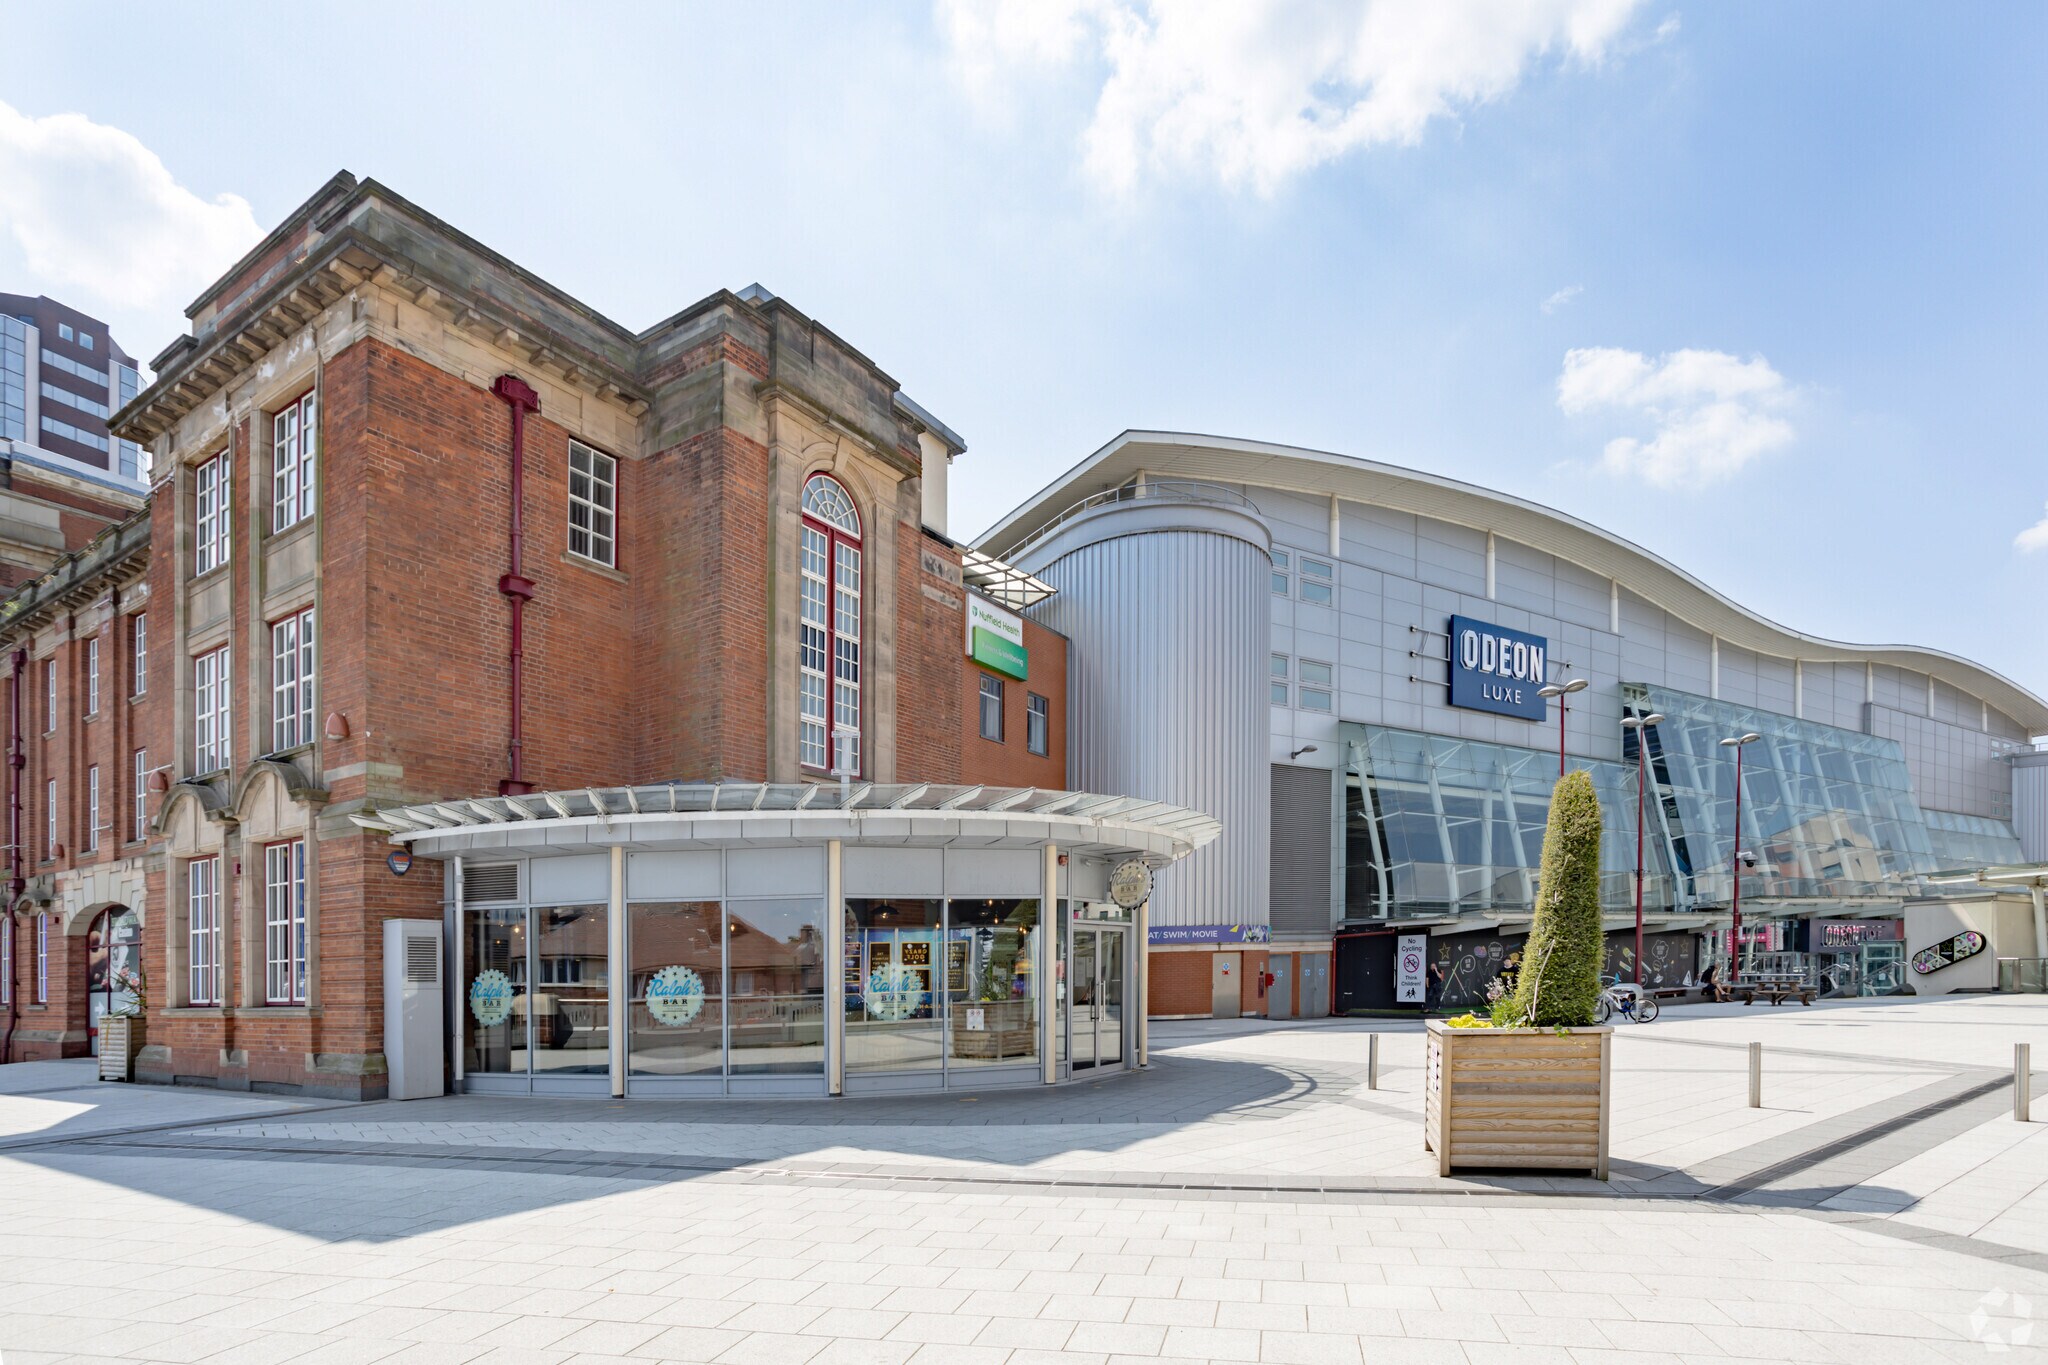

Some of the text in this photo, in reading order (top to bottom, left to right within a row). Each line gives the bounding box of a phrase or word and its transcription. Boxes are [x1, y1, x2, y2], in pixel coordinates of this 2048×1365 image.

[1002, 621, 1020, 637] Health
[1460, 630, 1543, 684] ODEON
[1483, 683, 1522, 704] LUXE
[1192, 930, 1218, 938] MOVIE
[1401, 945, 1422, 953] Cycling
[472, 982, 511, 1003] Ralph's
[650, 979, 700, 1002] Ralph's
[870, 976, 919, 1000] Ralph's
